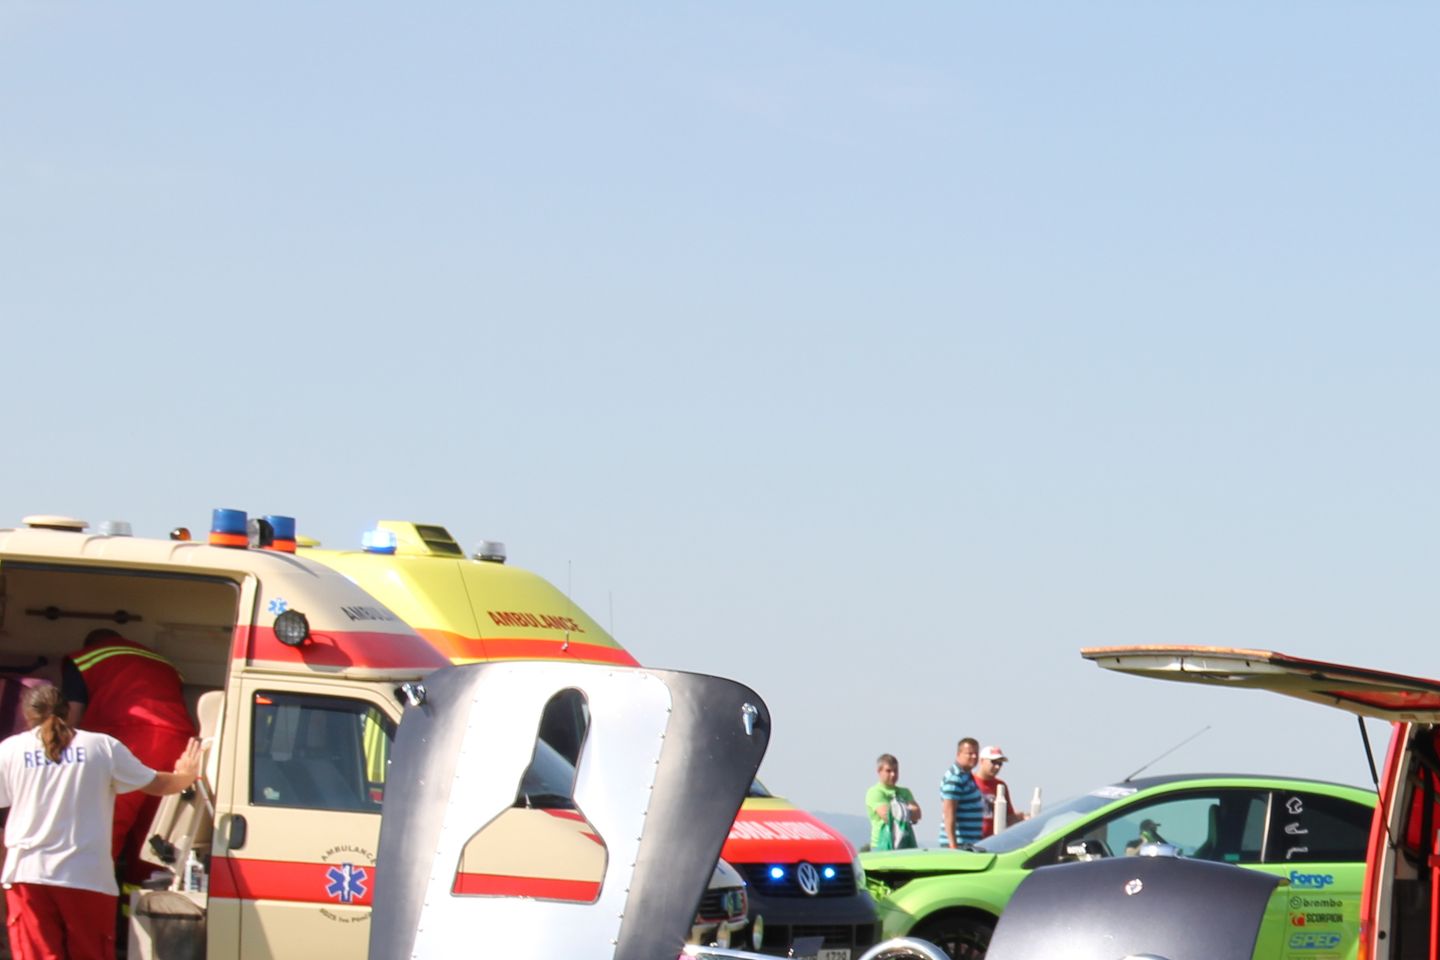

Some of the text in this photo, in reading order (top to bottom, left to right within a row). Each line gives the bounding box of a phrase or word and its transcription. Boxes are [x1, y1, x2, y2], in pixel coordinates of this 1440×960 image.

[487, 611, 585, 632] AMBULANCE
[24, 747, 86, 768] REUE
[1303, 899, 1343, 908] brembo
